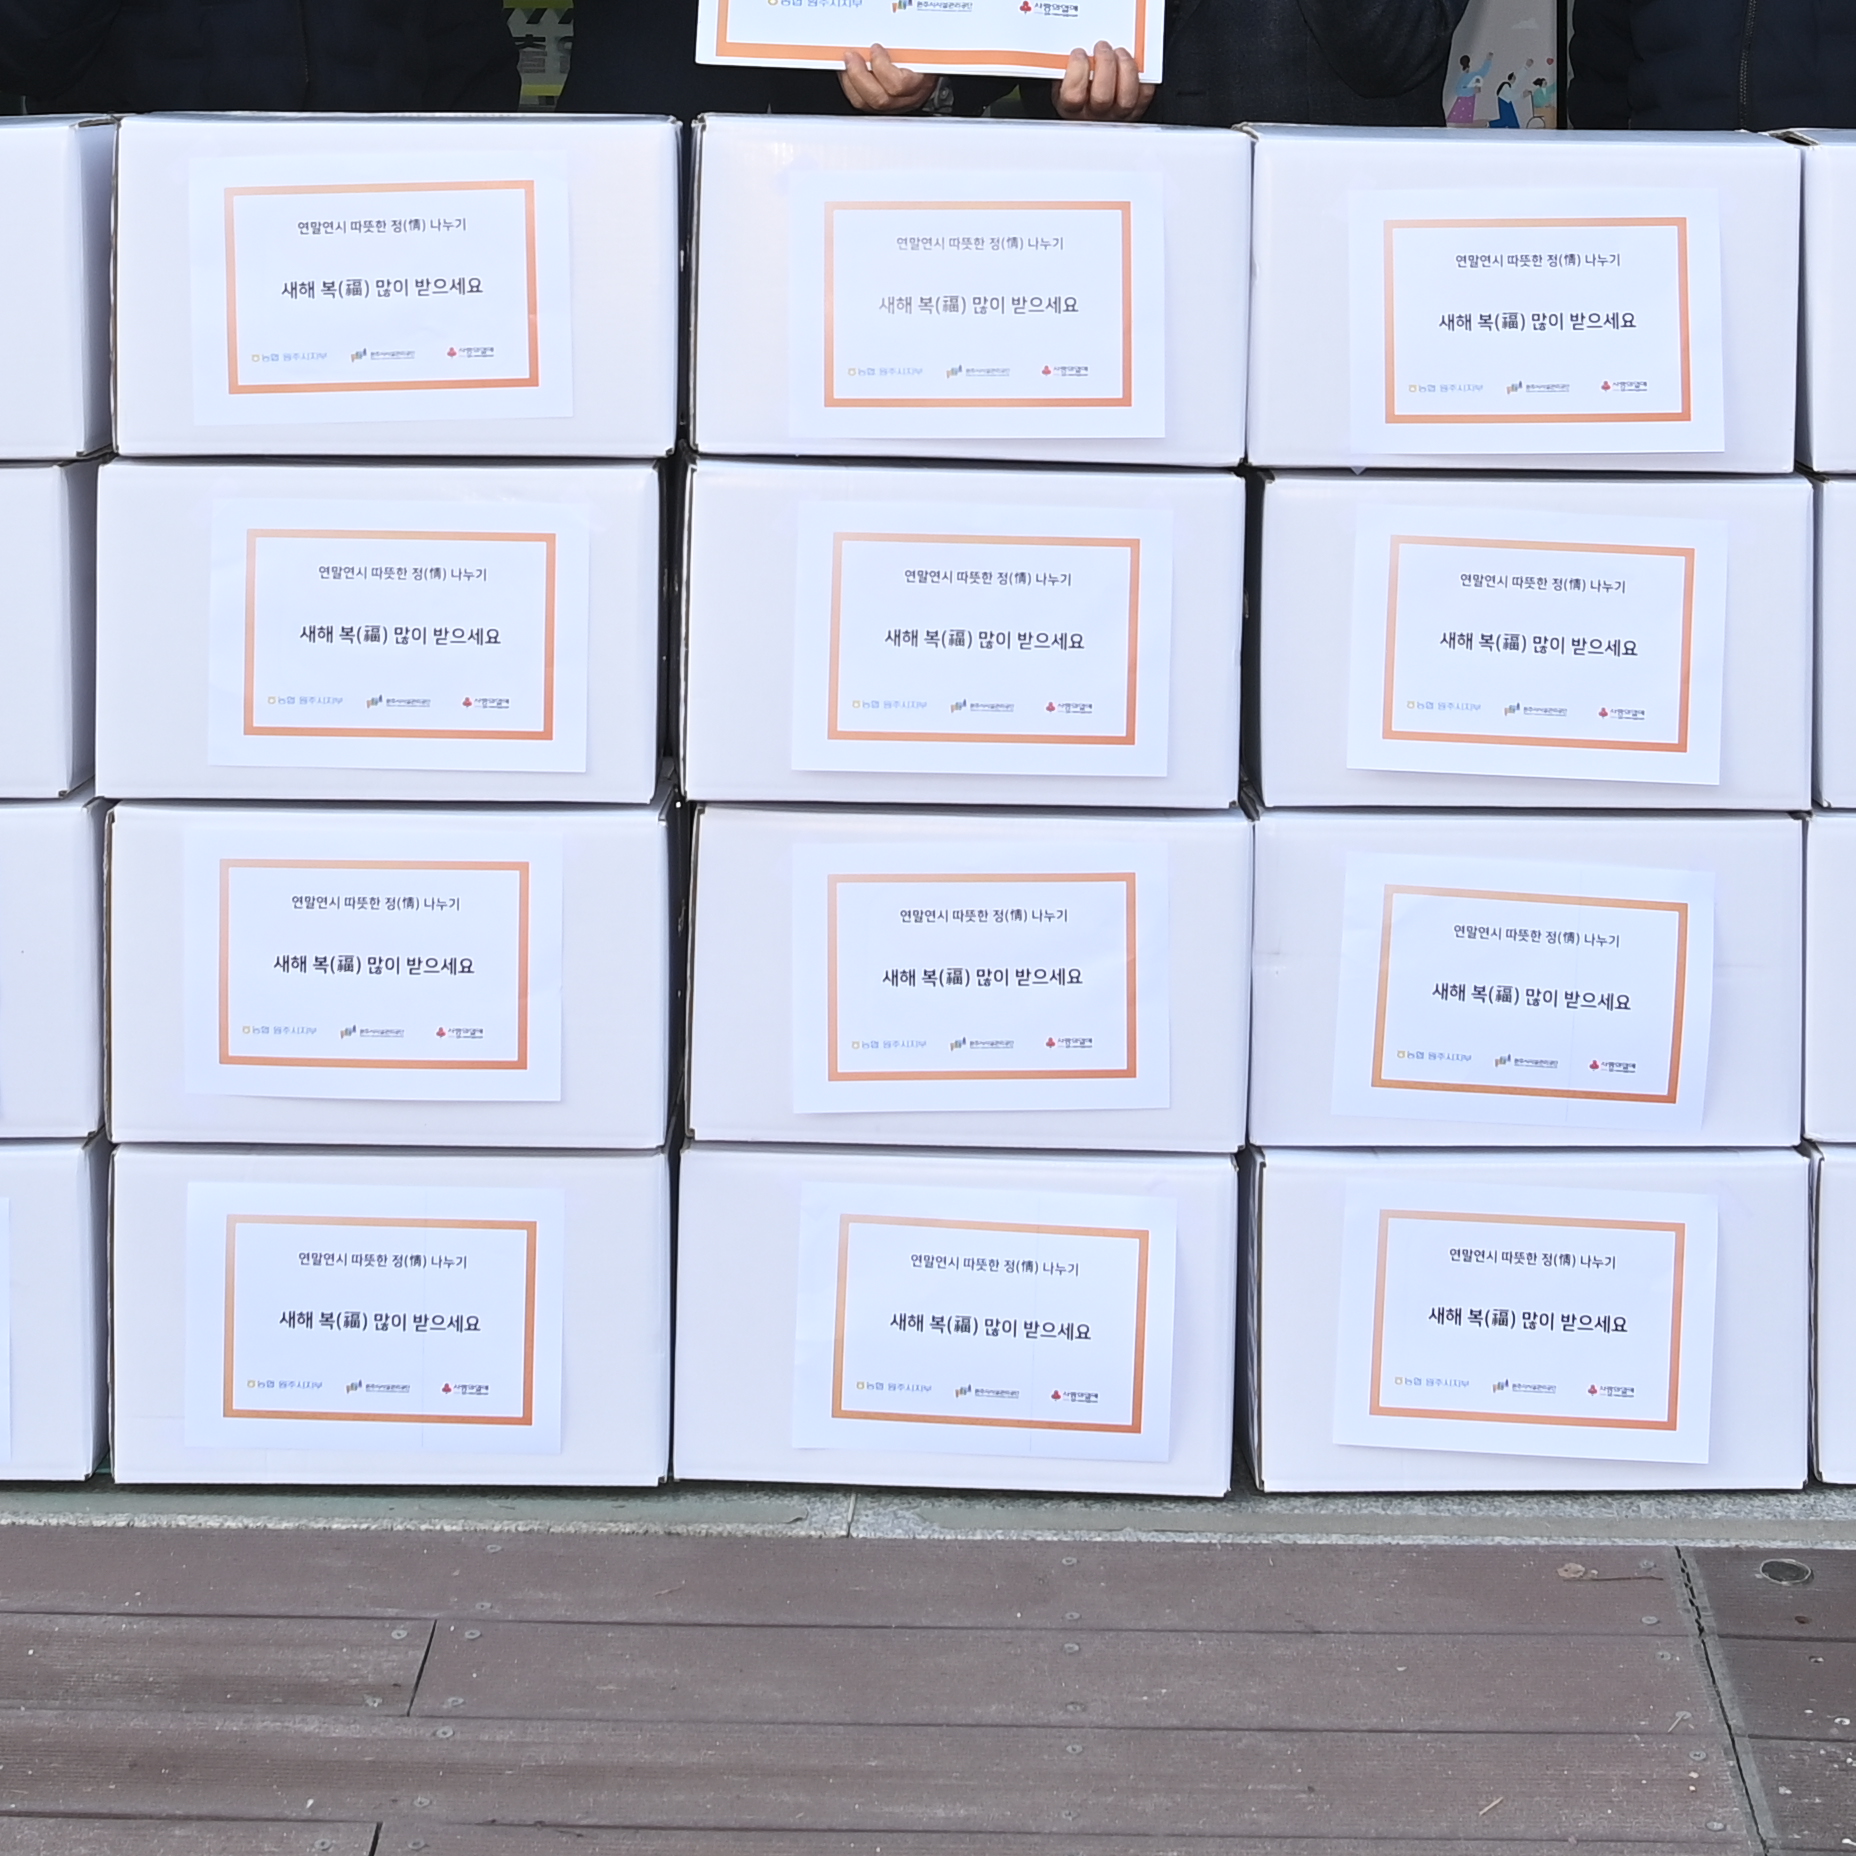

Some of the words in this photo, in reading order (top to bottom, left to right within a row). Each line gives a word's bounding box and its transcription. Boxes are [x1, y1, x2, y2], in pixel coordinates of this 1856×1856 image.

[281, 280, 316, 300] 새해
[375, 278, 409, 298] 많이
[414, 276, 484, 297] 받으세요
[1438, 312, 1473, 332] 새해
[1531, 311, 1564, 332] 많이
[1569, 311, 1637, 331] 받으세요
[1460, 573, 1509, 589] 연말연시
[1511, 575, 1548, 591] 따뜻한
[1589, 578, 1626, 595] 나누기
[299, 624, 334, 644] 새해
[393, 626, 427, 646] 많이
[433, 626, 502, 647] 받으세요
[1439, 631, 1474, 651] 새해
[1532, 635, 1565, 656] 많이
[1571, 636, 1639, 658] 받으세요
[273, 954, 308, 974] 새해
[367, 955, 400, 976] 많이
[406, 956, 475, 976] 받으세요
[1431, 982, 1466, 1003] 새해
[1525, 987, 1558, 1009] 많이
[1564, 990, 1632, 1012] 받으세요
[1449, 1247, 1498, 1264] 연말연시
[1501, 1250, 1538, 1266] 따뜻한
[1580, 1254, 1616, 1271] 나누기
[278, 1310, 314, 1330] 새해
[373, 1312, 407, 1333] 많이
[412, 1313, 482, 1334] 받으세요
[1428, 1306, 1463, 1327] 새해
[1521, 1310, 1555, 1332] 많이
[1560, 1312, 1628, 1335] 받으세요
